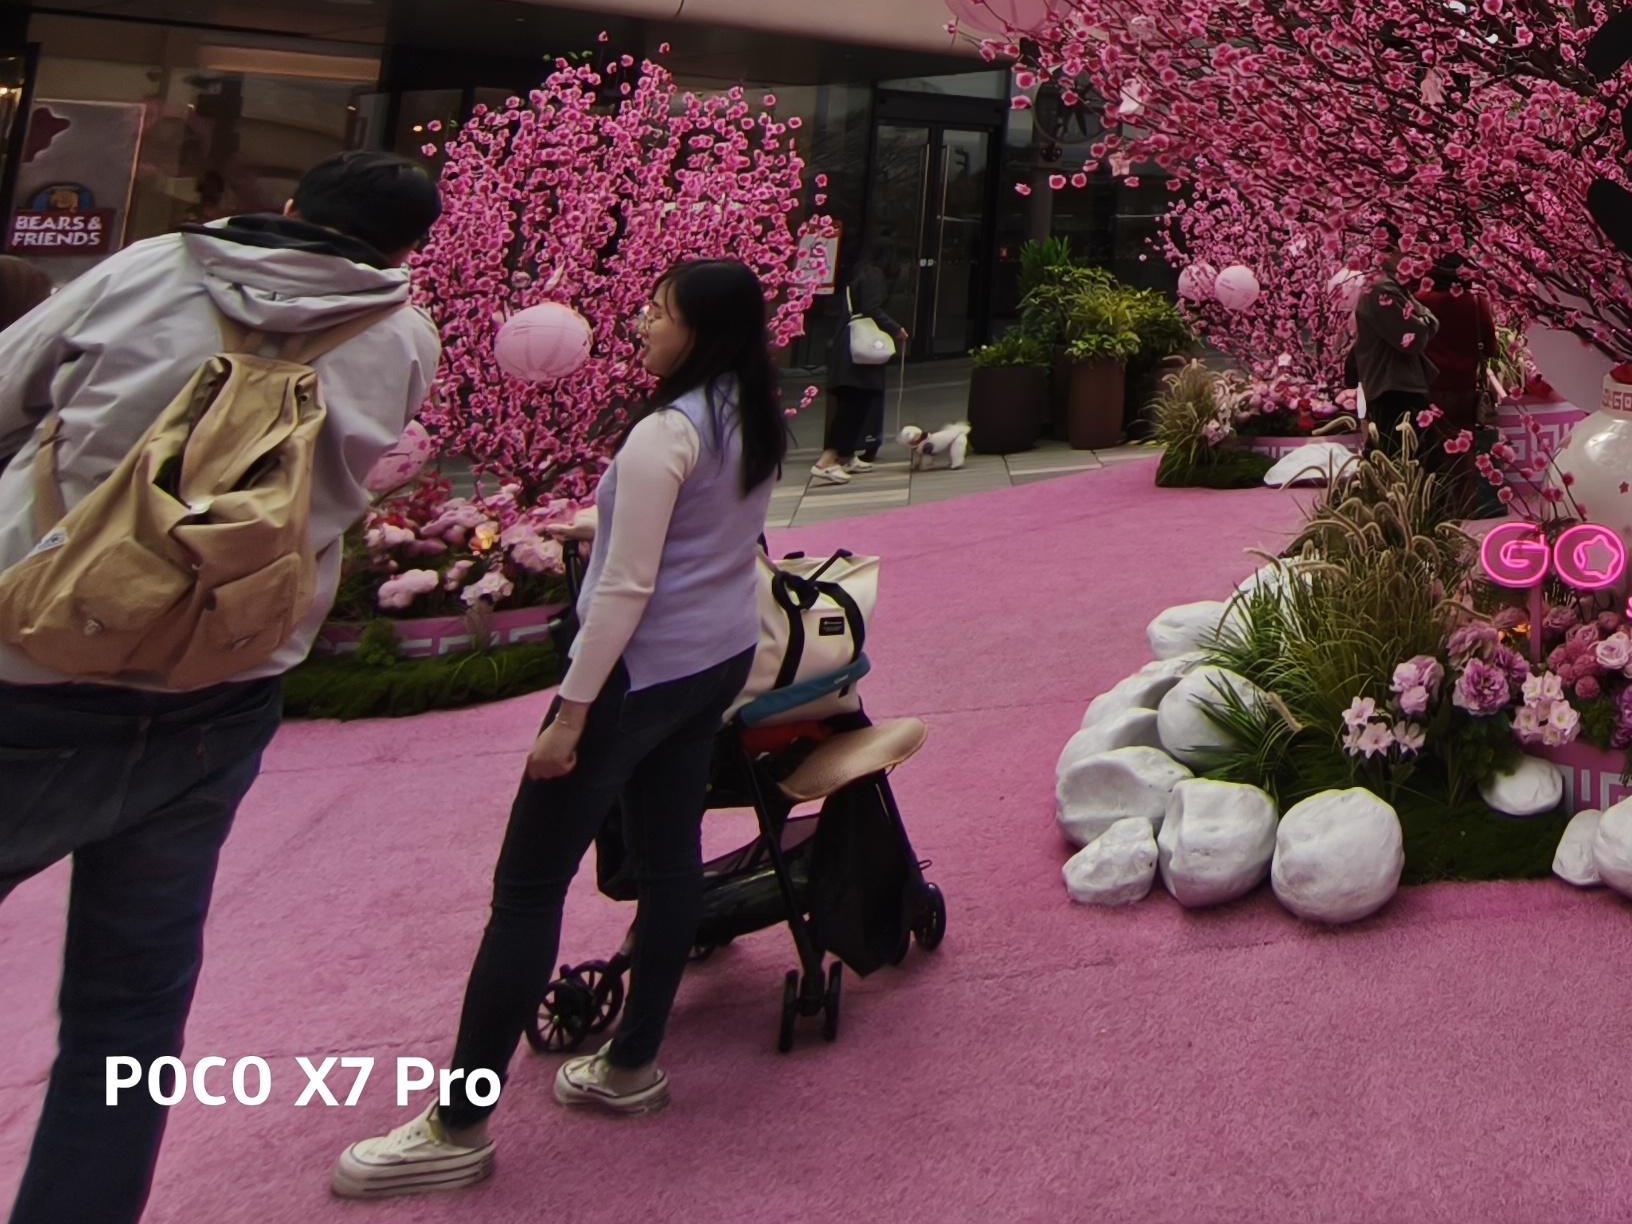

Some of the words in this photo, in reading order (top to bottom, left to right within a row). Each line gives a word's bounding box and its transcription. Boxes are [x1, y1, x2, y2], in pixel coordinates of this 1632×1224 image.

[15, 215, 85, 230] BEARS
[87, 216, 102, 230] &
[11, 232, 101, 246] FRIENDS
[1481, 522, 1626, 589] GO
